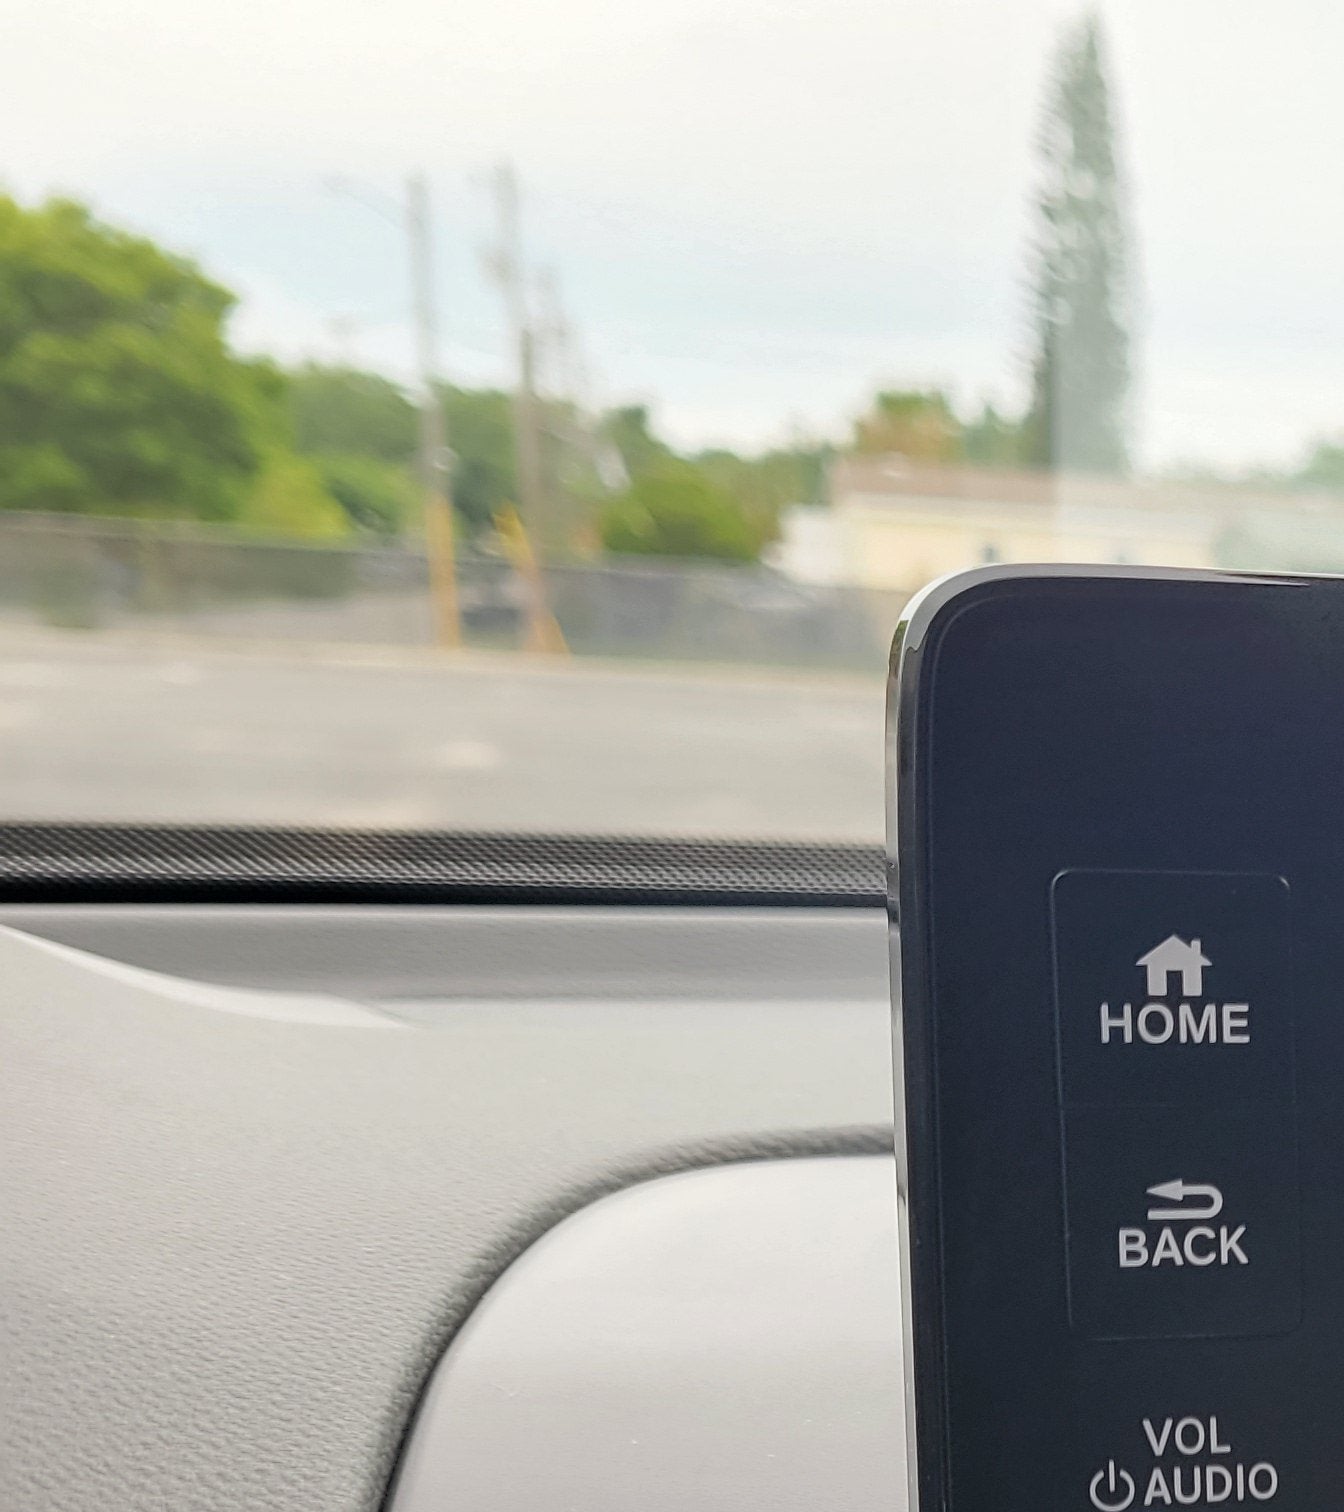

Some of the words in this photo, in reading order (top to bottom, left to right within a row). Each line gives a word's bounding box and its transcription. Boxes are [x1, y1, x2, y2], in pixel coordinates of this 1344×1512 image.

[1100, 1002, 1250, 1044] HOME
[1118, 1225, 1248, 1269] BACK
[1142, 1416, 1231, 1457] VOL
[1144, 1461, 1279, 1506] AUDIO
